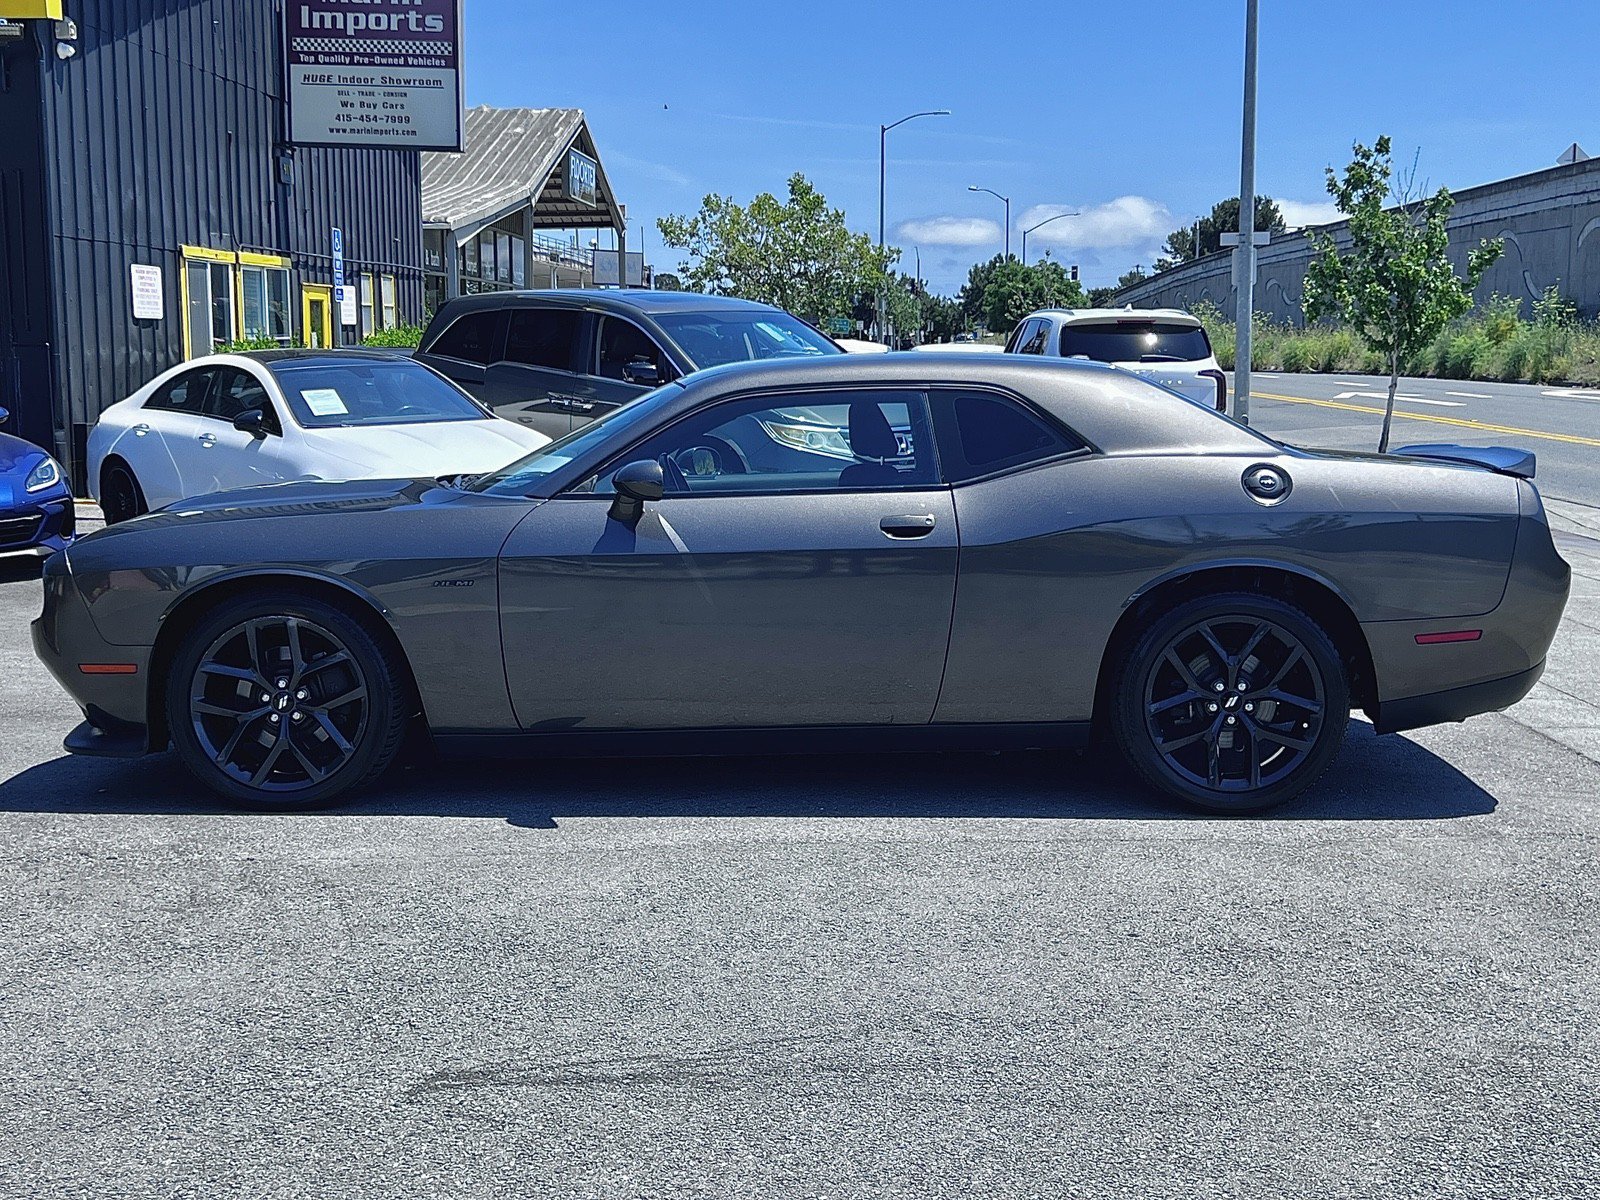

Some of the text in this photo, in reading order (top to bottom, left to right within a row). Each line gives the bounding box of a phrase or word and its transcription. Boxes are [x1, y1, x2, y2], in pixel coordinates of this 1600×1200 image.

[301, 5, 444, 36] Imports
[299, 53, 446, 66] Top Quality Pre-Owned Vehicles
[303, 73, 442, 86] HUGE Indoor Showroom
[340, 100, 405, 110] We Buy Cars
[335, 113, 411, 124] 415-454-7999
[328, 126, 417, 136] www.marinimports.com
[433, 579, 475, 587] HEMI
